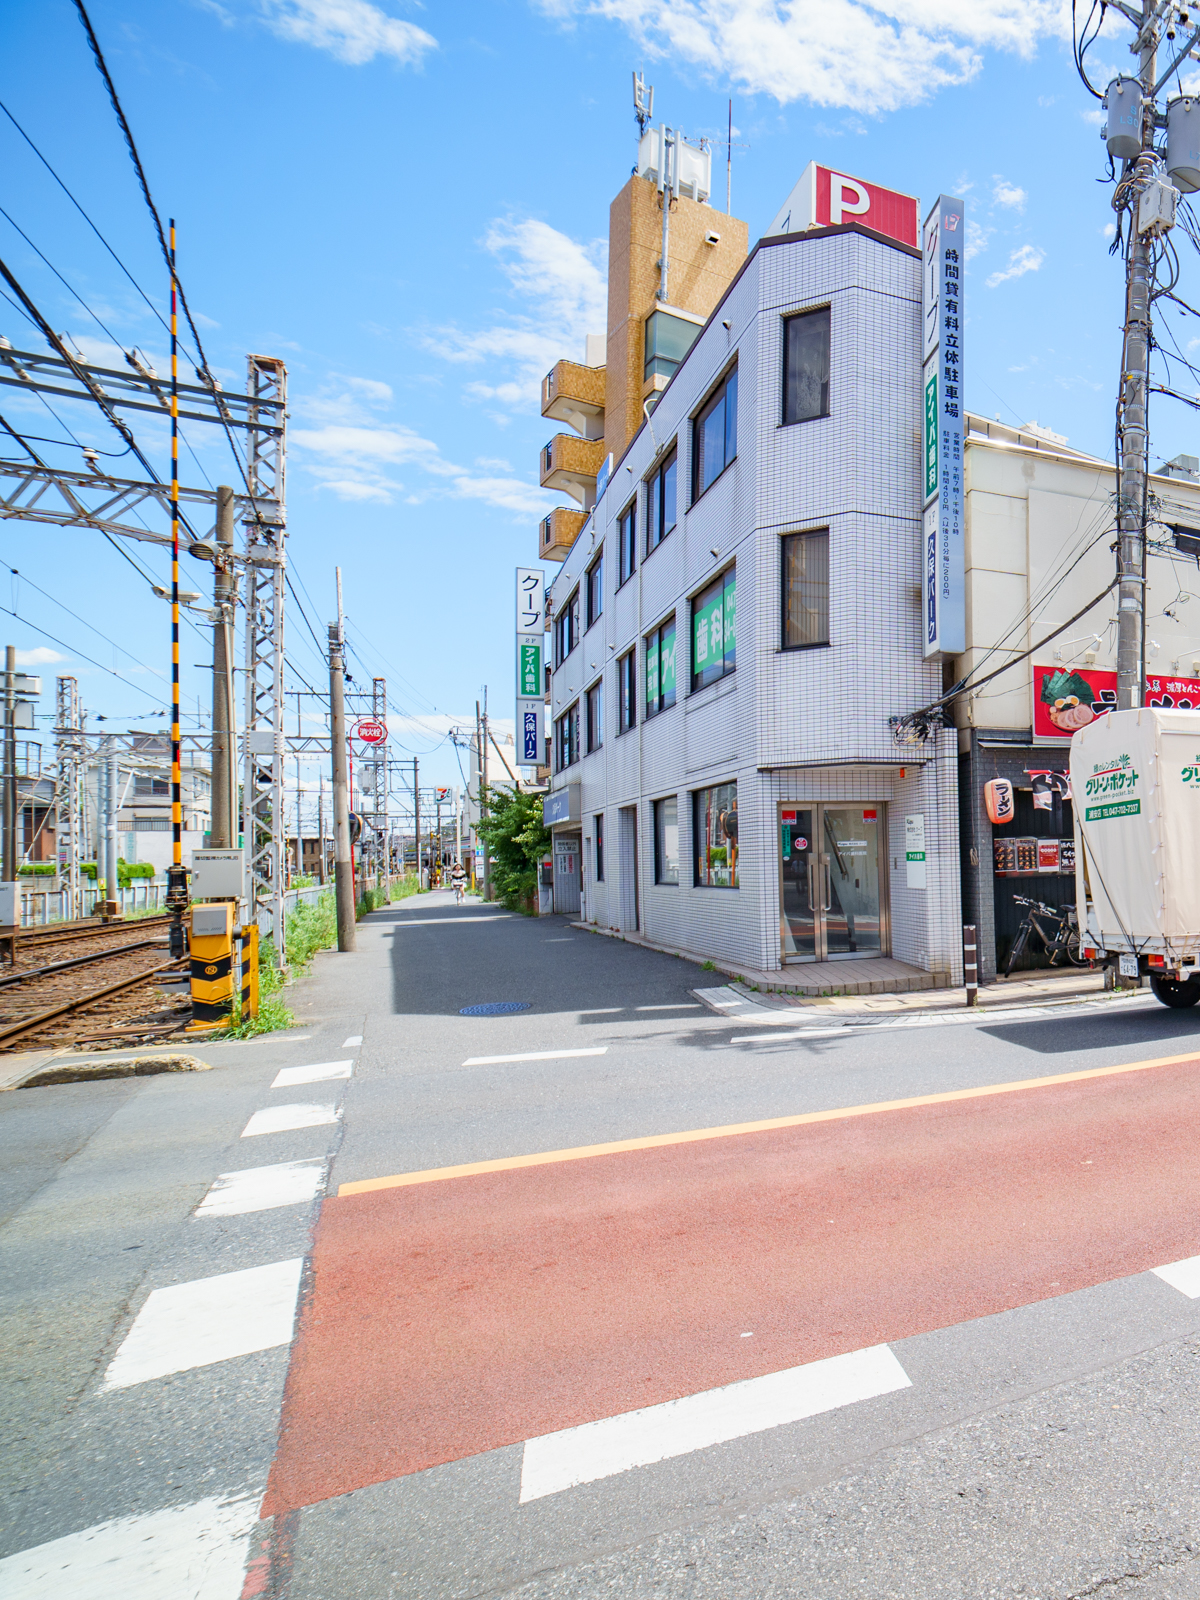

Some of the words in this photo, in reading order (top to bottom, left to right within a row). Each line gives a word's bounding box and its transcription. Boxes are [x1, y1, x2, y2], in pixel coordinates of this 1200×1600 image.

[830, 173, 871, 225] P
[944, 248, 960, 418] 時間貸有料立体駐車場
[521, 575, 542, 628] クープ
[696, 604, 723, 664] 歯科
[525, 647, 536, 693] アイバ歯科
[359, 727, 382, 737] 消火栓
[525, 713, 536, 759] 久保パーク
[995, 783, 1011, 817] ラーメン
[1088, 808, 1102, 819] 浦安店
[1090, 788, 1135, 802] www.green-pocket.biz
